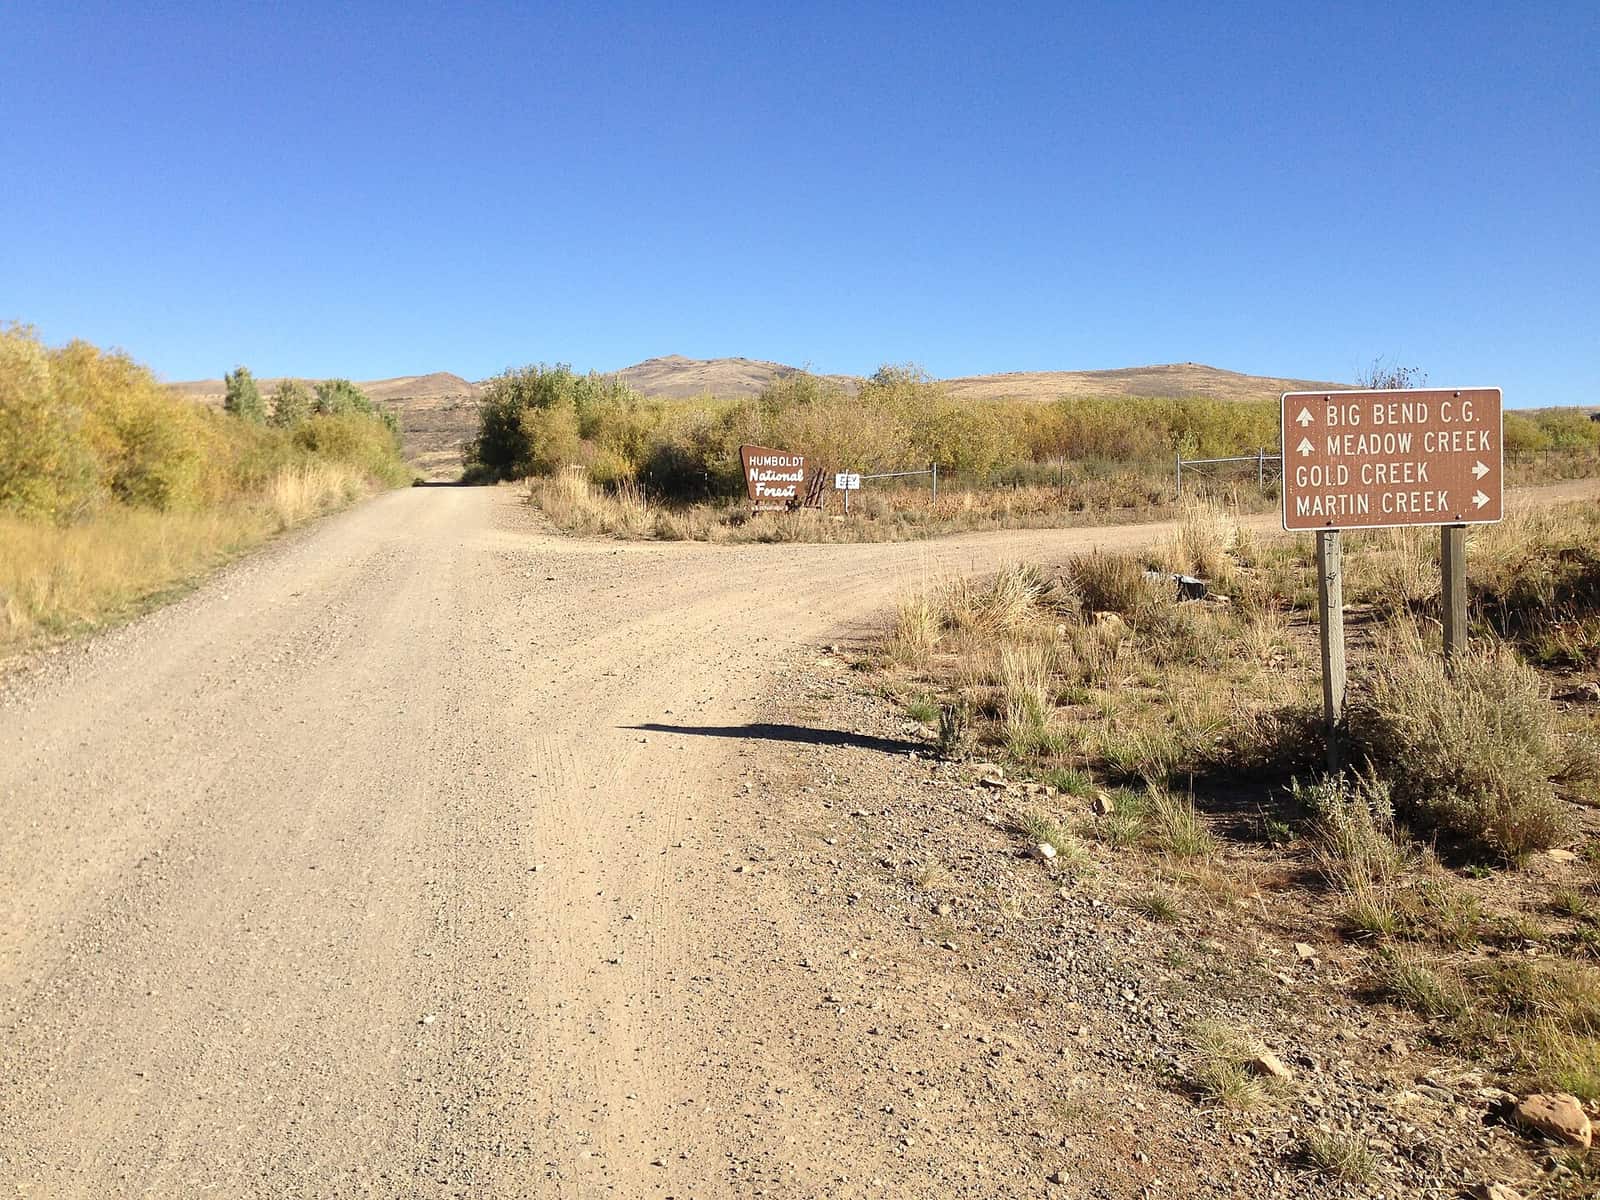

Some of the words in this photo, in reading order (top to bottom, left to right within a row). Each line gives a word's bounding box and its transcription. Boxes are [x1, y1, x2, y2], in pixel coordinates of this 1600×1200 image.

[1326, 404, 1361, 426] BIG
[1373, 403, 1428, 425] BEND
[1440, 401, 1480, 422] C.G.
[1327, 433, 1412, 456] MEADOW
[1424, 430, 1490, 453] CREEK
[749, 456, 804, 467] HUMBOLDT
[749, 468, 804, 482] National
[1296, 464, 1349, 488] GOLD
[1361, 462, 1429, 485] CREEK
[755, 482, 796, 497] Forest
[1296, 493, 1369, 517] MARTIN
[1382, 490, 1449, 513] CREEK
